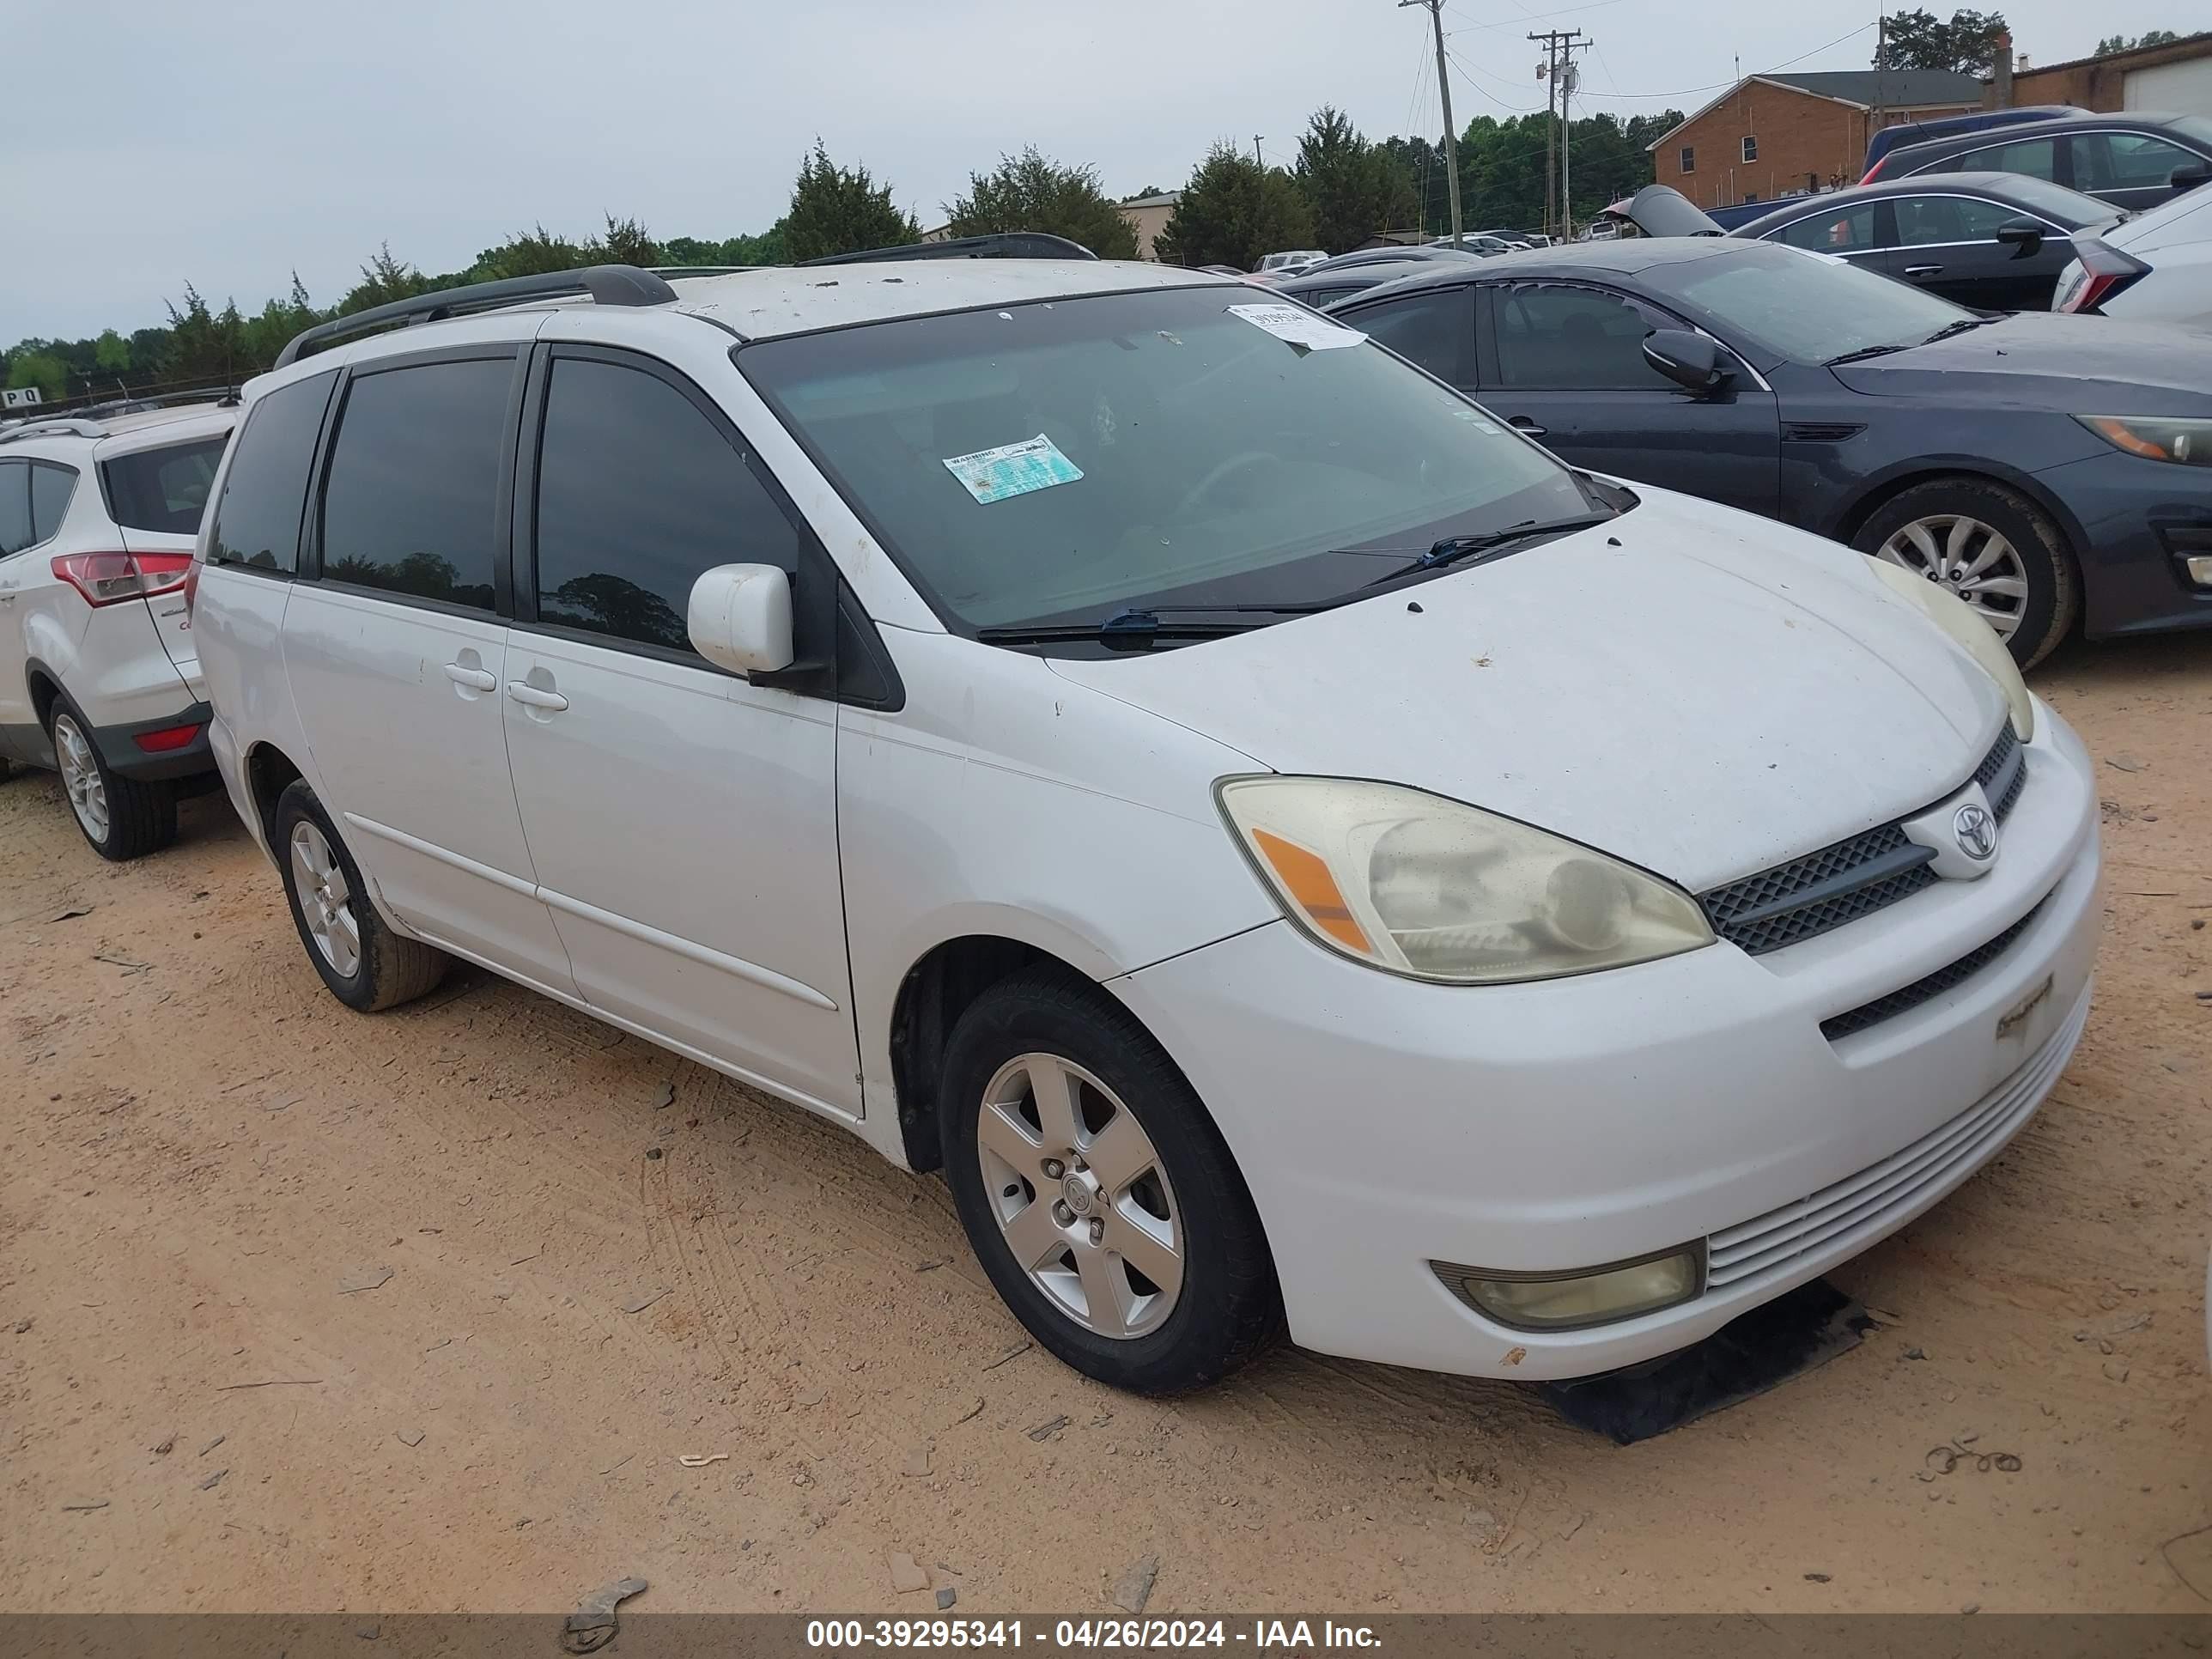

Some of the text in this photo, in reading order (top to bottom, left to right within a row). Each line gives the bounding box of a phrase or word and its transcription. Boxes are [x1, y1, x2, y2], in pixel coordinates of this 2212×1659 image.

[7, 389, 36, 404] P Q
[951, 450, 996, 465] WARNING
